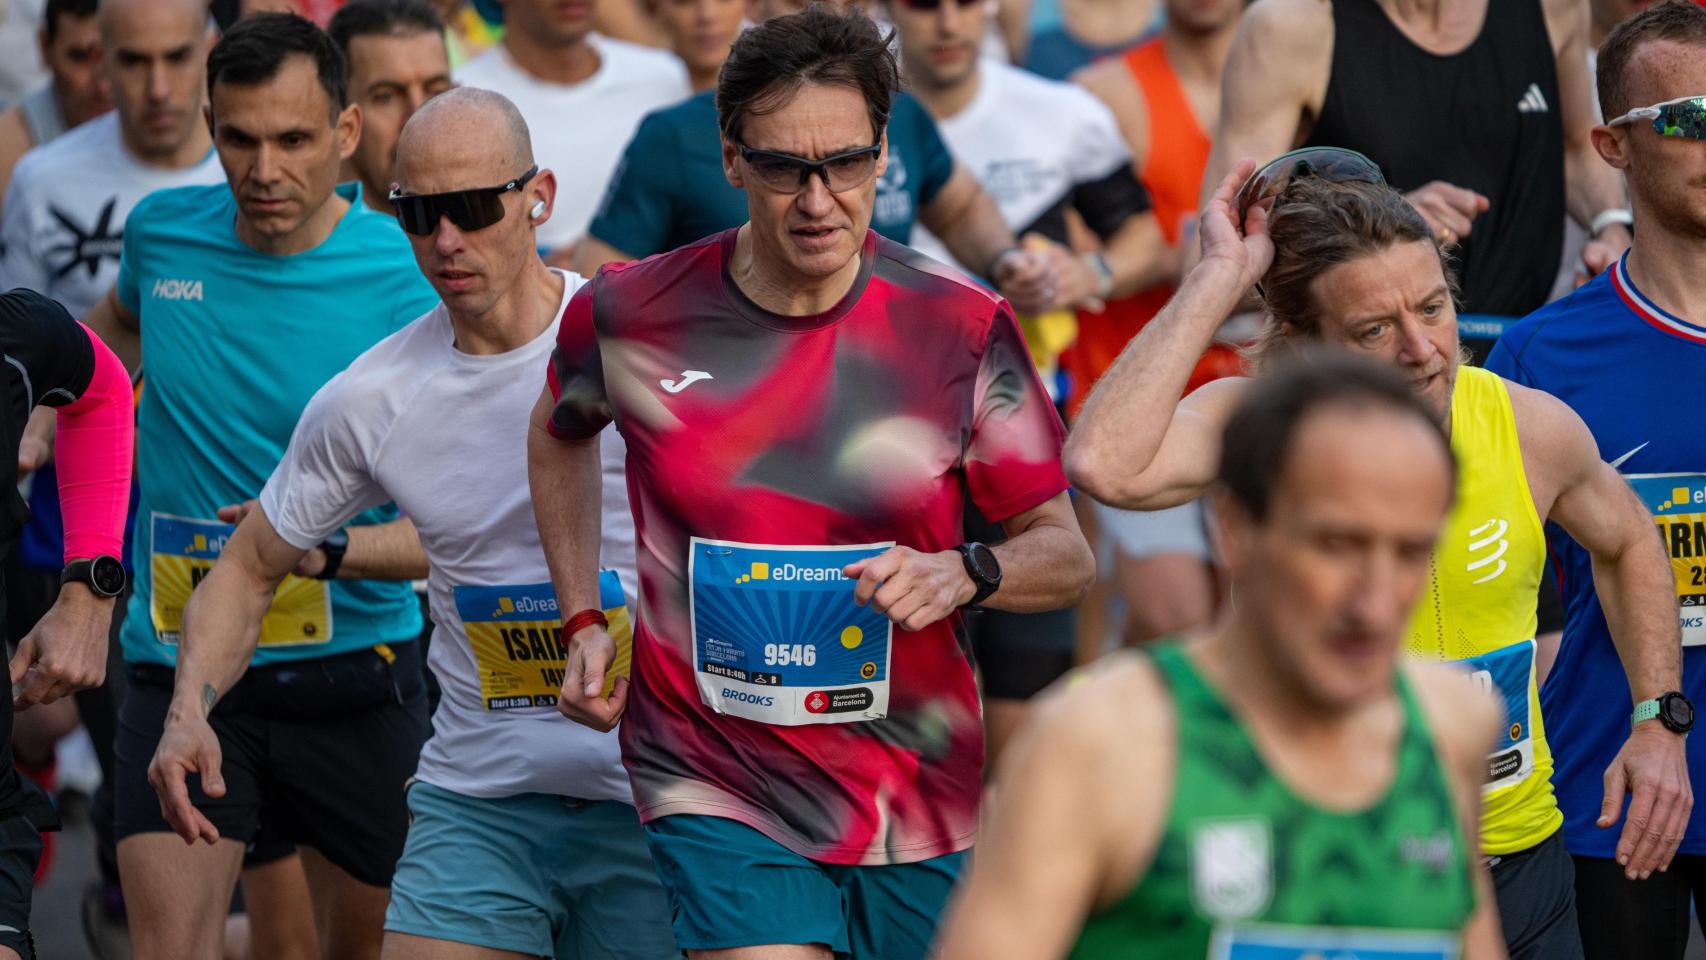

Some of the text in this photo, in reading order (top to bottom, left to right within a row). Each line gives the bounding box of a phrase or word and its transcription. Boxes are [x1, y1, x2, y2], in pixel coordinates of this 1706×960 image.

[152, 278, 203, 301] HOKA
[516, 597, 557, 612] eDrea
[500, 628, 568, 661] ISAIA
[764, 643, 817, 667] 9546
[706, 664, 746, 680] Start 8:40h
[721, 688, 774, 707] BROOKS
[832, 699, 866, 708] Barcelona
[833, 693, 860, 701] Ajuntament
